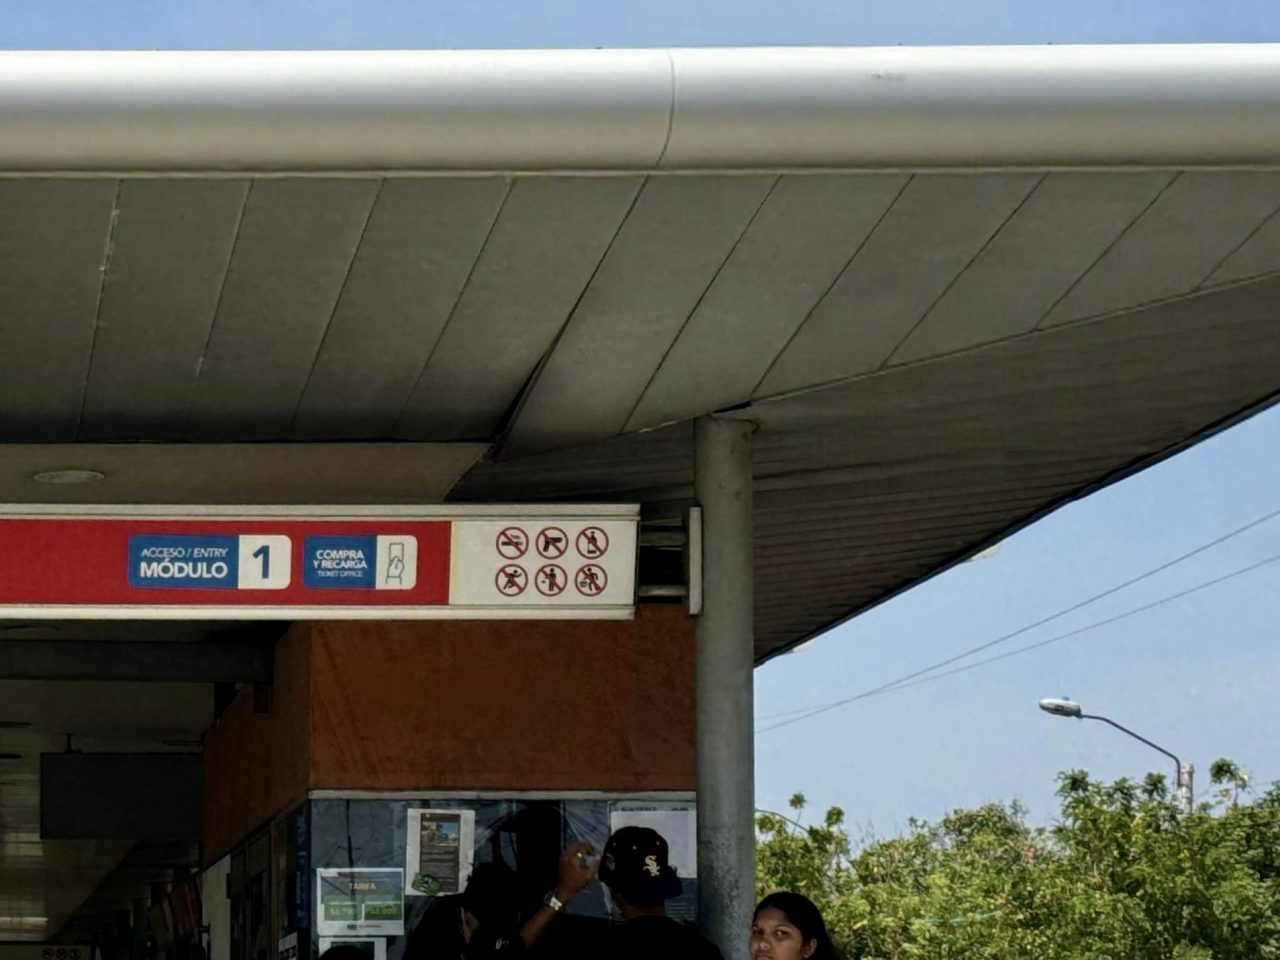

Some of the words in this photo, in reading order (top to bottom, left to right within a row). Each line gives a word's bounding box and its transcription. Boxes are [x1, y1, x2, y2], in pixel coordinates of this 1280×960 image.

[141, 547, 185, 558] ACCESO
[193, 547, 228, 558] ENTRY
[316, 550, 365, 559] COMPRA
[252, 545, 270, 579] 1
[313, 560, 320, 569] Y
[321, 560, 368, 569] RECARGA
[140, 558, 228, 578] MÓDULO
